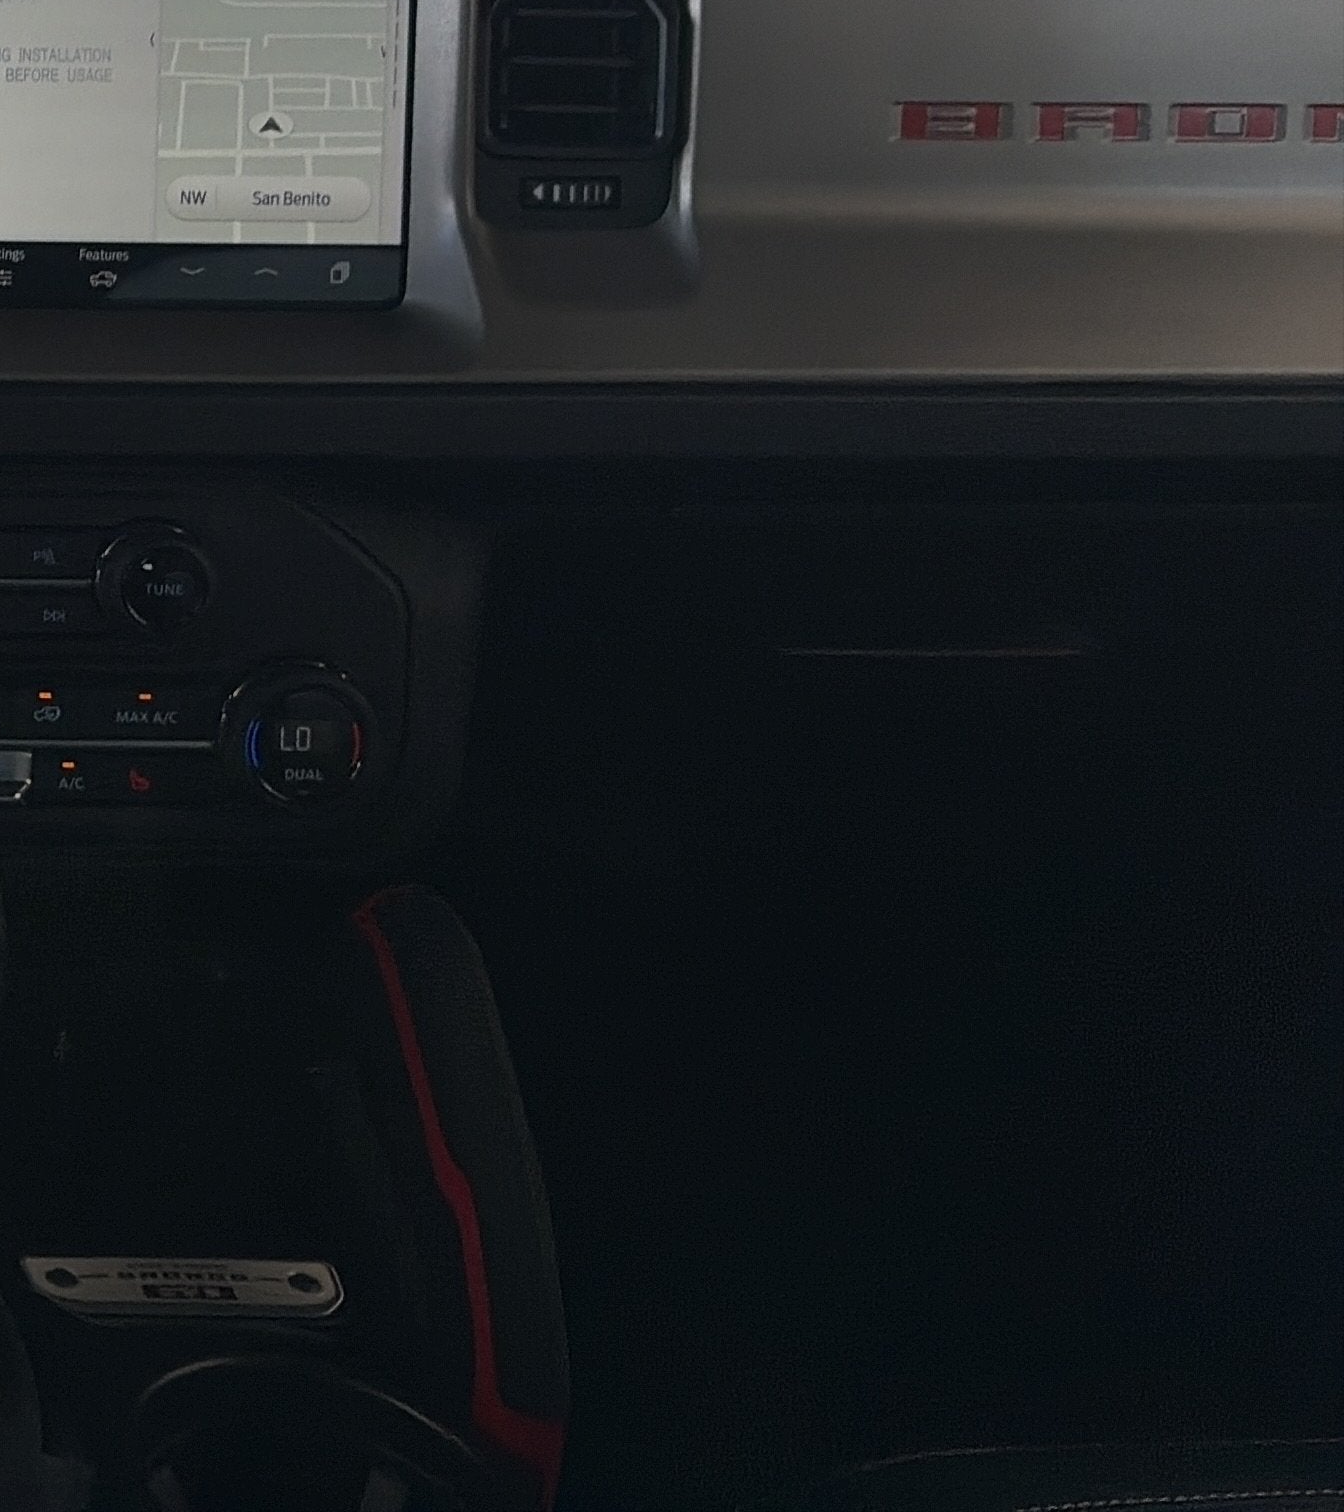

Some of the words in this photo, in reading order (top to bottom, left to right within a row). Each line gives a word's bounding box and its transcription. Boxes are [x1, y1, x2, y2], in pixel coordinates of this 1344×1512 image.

[18, 47, 112, 64] INSTALLATION
[5, 68, 61, 83] BEFORE
[67, 68, 113, 84] USAGE
[179, 189, 208, 207] NW
[252, 189, 279, 208] San
[284, 188, 332, 208] Benito
[78, 246, 130, 262] Features
[145, 582, 184, 596] TUNE
[116, 709, 148, 726] MAX
[152, 708, 179, 726] A/C
[280, 726, 313, 752] LO
[58, 775, 86, 790] A/C
[284, 767, 324, 783] DUAL
